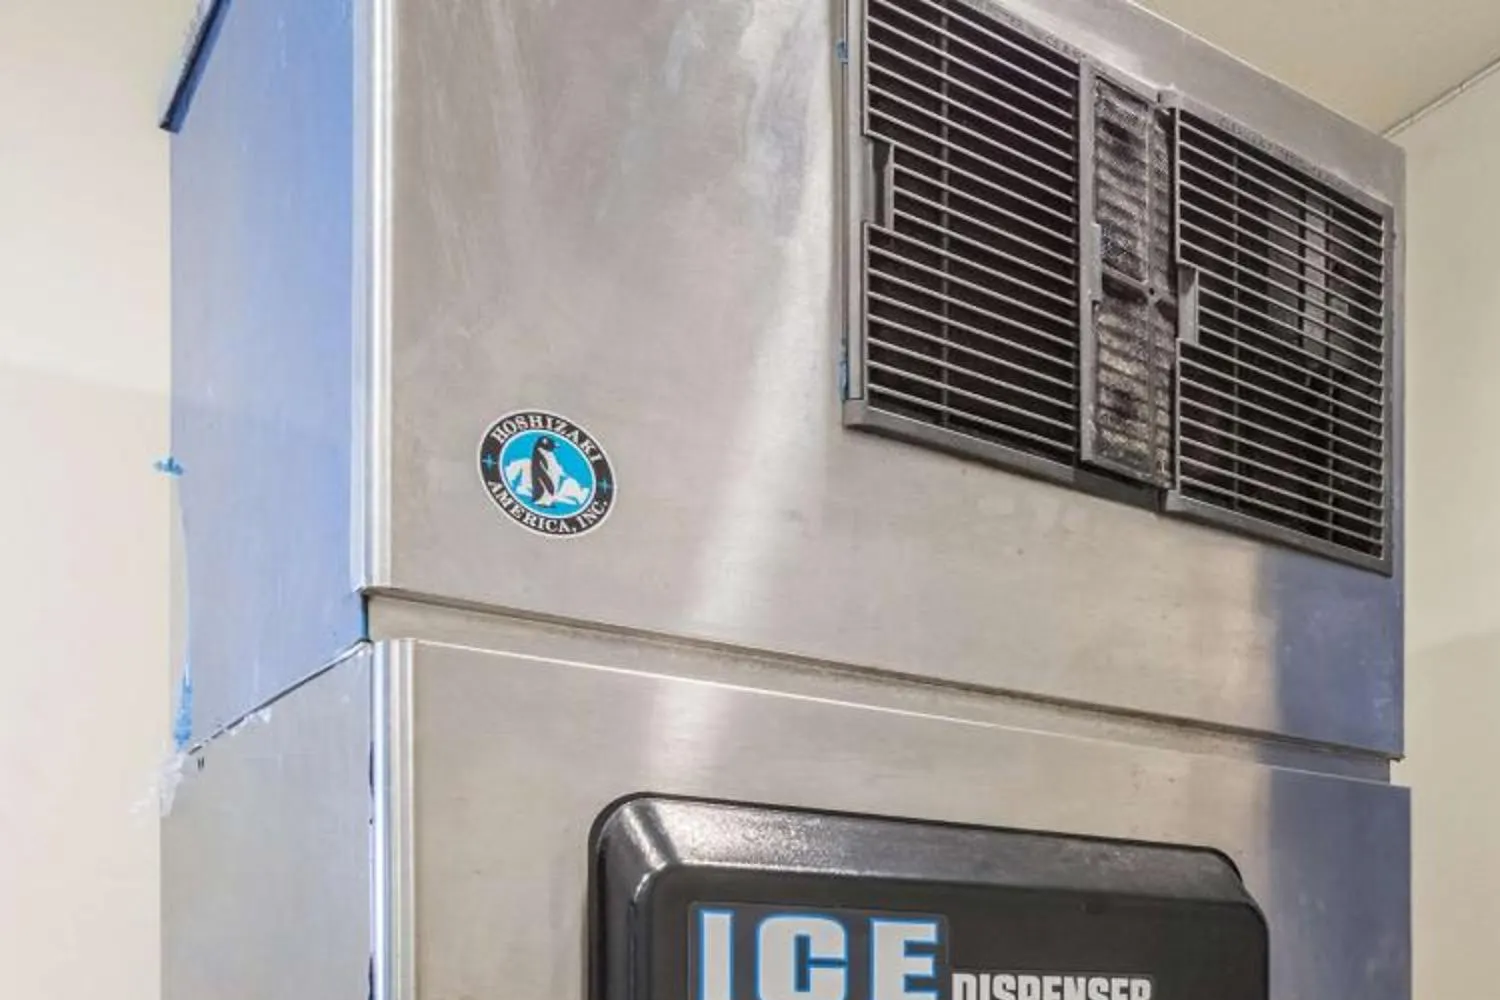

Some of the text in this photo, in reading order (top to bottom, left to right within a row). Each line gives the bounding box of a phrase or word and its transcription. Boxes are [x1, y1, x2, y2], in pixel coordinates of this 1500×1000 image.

[490, 414, 603, 463] HOSHIZAKI
[487, 480, 608, 534] AMERICA, INC.
